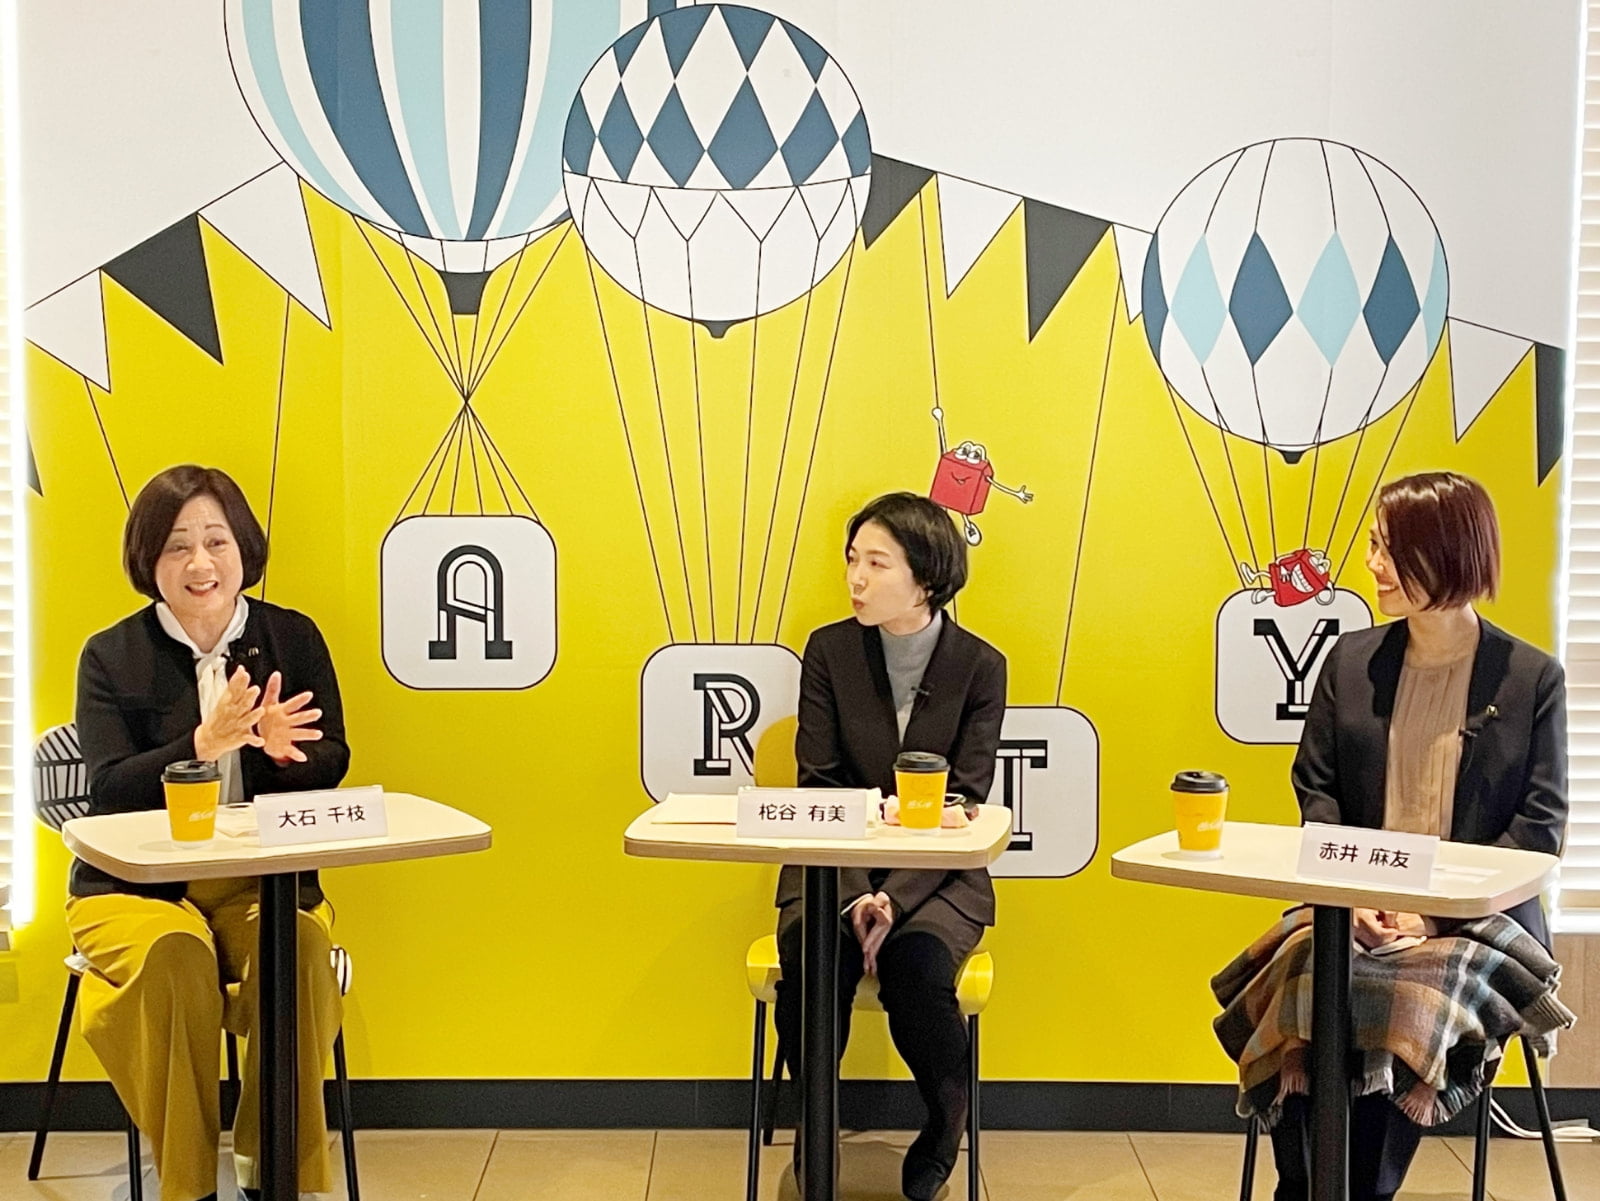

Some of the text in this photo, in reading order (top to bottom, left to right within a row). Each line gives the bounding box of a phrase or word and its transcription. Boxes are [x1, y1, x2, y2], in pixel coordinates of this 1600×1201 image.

[428, 544, 513, 660] A
[1253, 618, 1340, 721] Y
[693, 673, 761, 776] R
[278, 804, 366, 829] 大石 千枝
[758, 802, 846, 822] 柁谷 有美
[1319, 841, 1411, 869] 赤井 麻友
